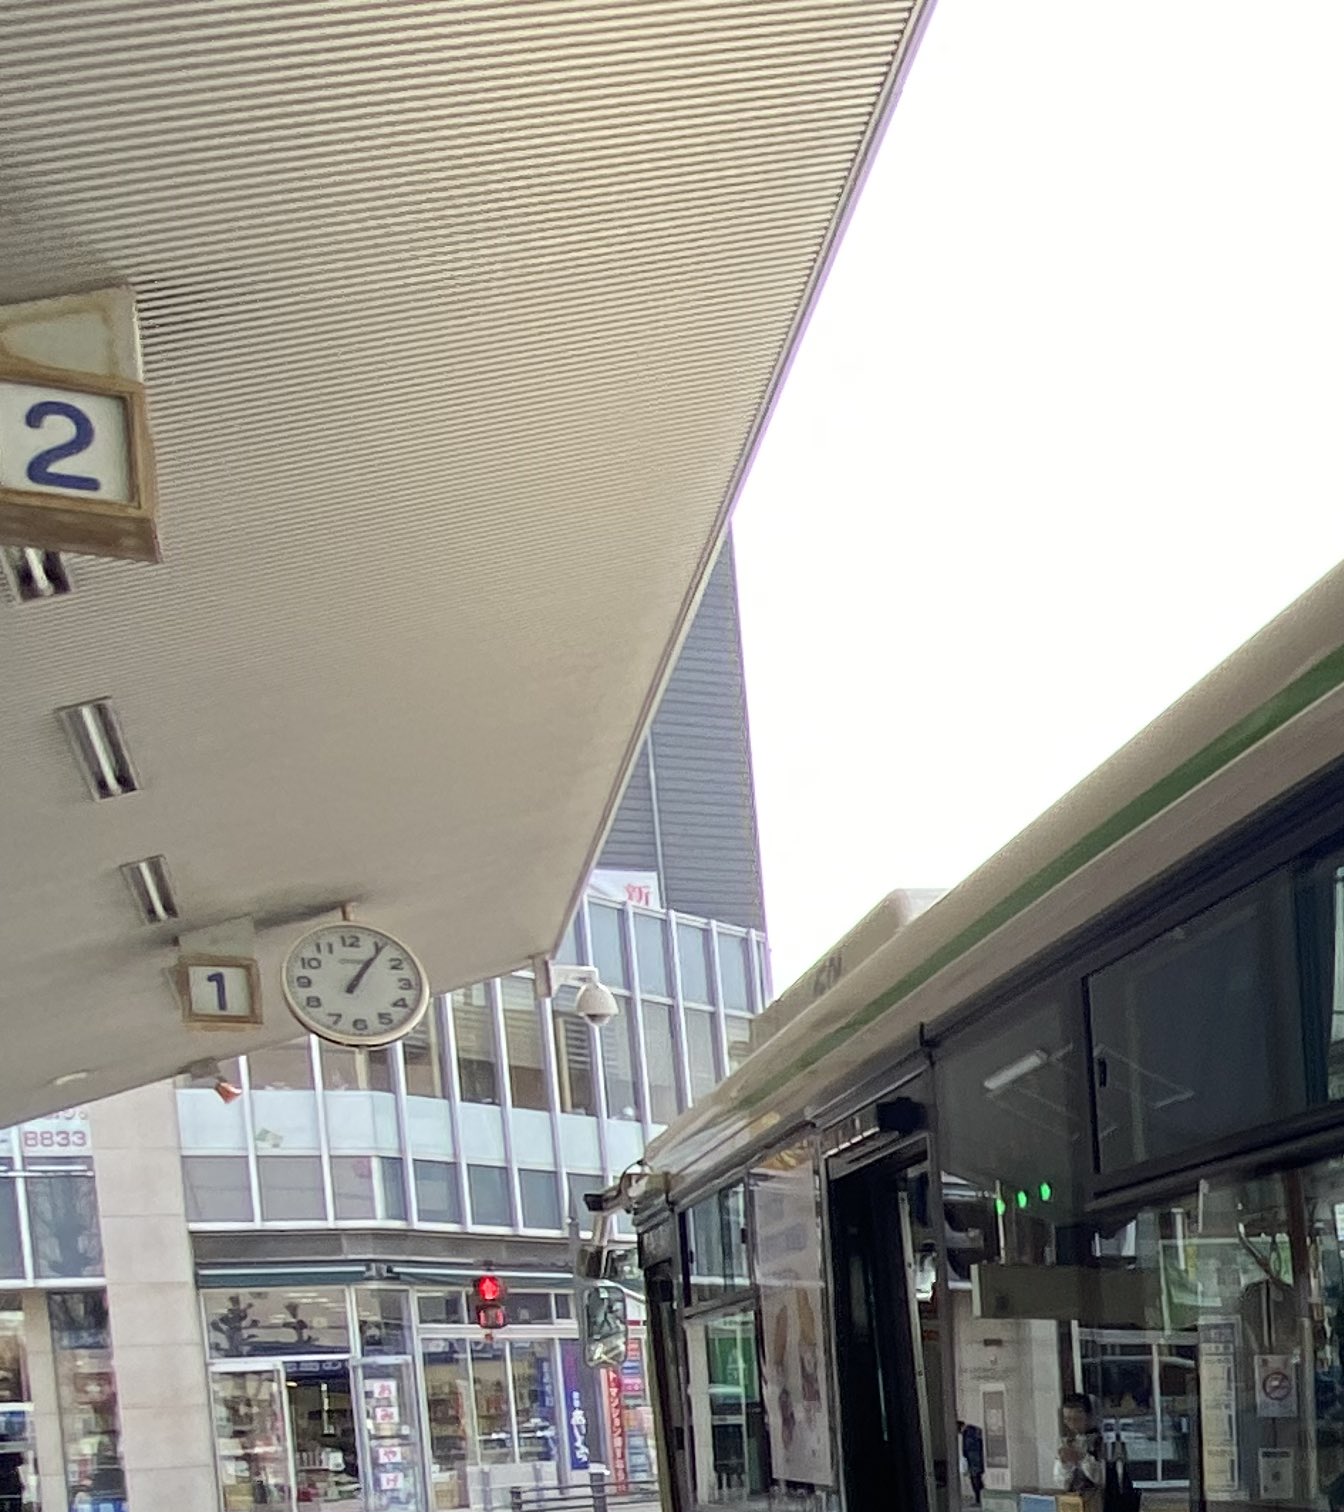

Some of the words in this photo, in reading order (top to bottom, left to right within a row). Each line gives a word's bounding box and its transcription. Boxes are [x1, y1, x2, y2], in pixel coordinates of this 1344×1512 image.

[24, 400, 102, 492] 2
[340, 934, 361, 948] 12
[315, 941, 334, 955] 11
[301, 957, 322, 970] 10
[389, 957, 404, 970] 2
[296, 975, 312, 988] 9
[398, 977, 412, 990] 3
[206, 971, 227, 1011] 1
[306, 996, 321, 1009] 8
[392, 998, 408, 1009] 4
[327, 1013, 342, 1025] 7
[352, 1019, 368, 1031] 6
[377, 1012, 393, 1026] 5
[23, 1130, 87, 1147] 8833
